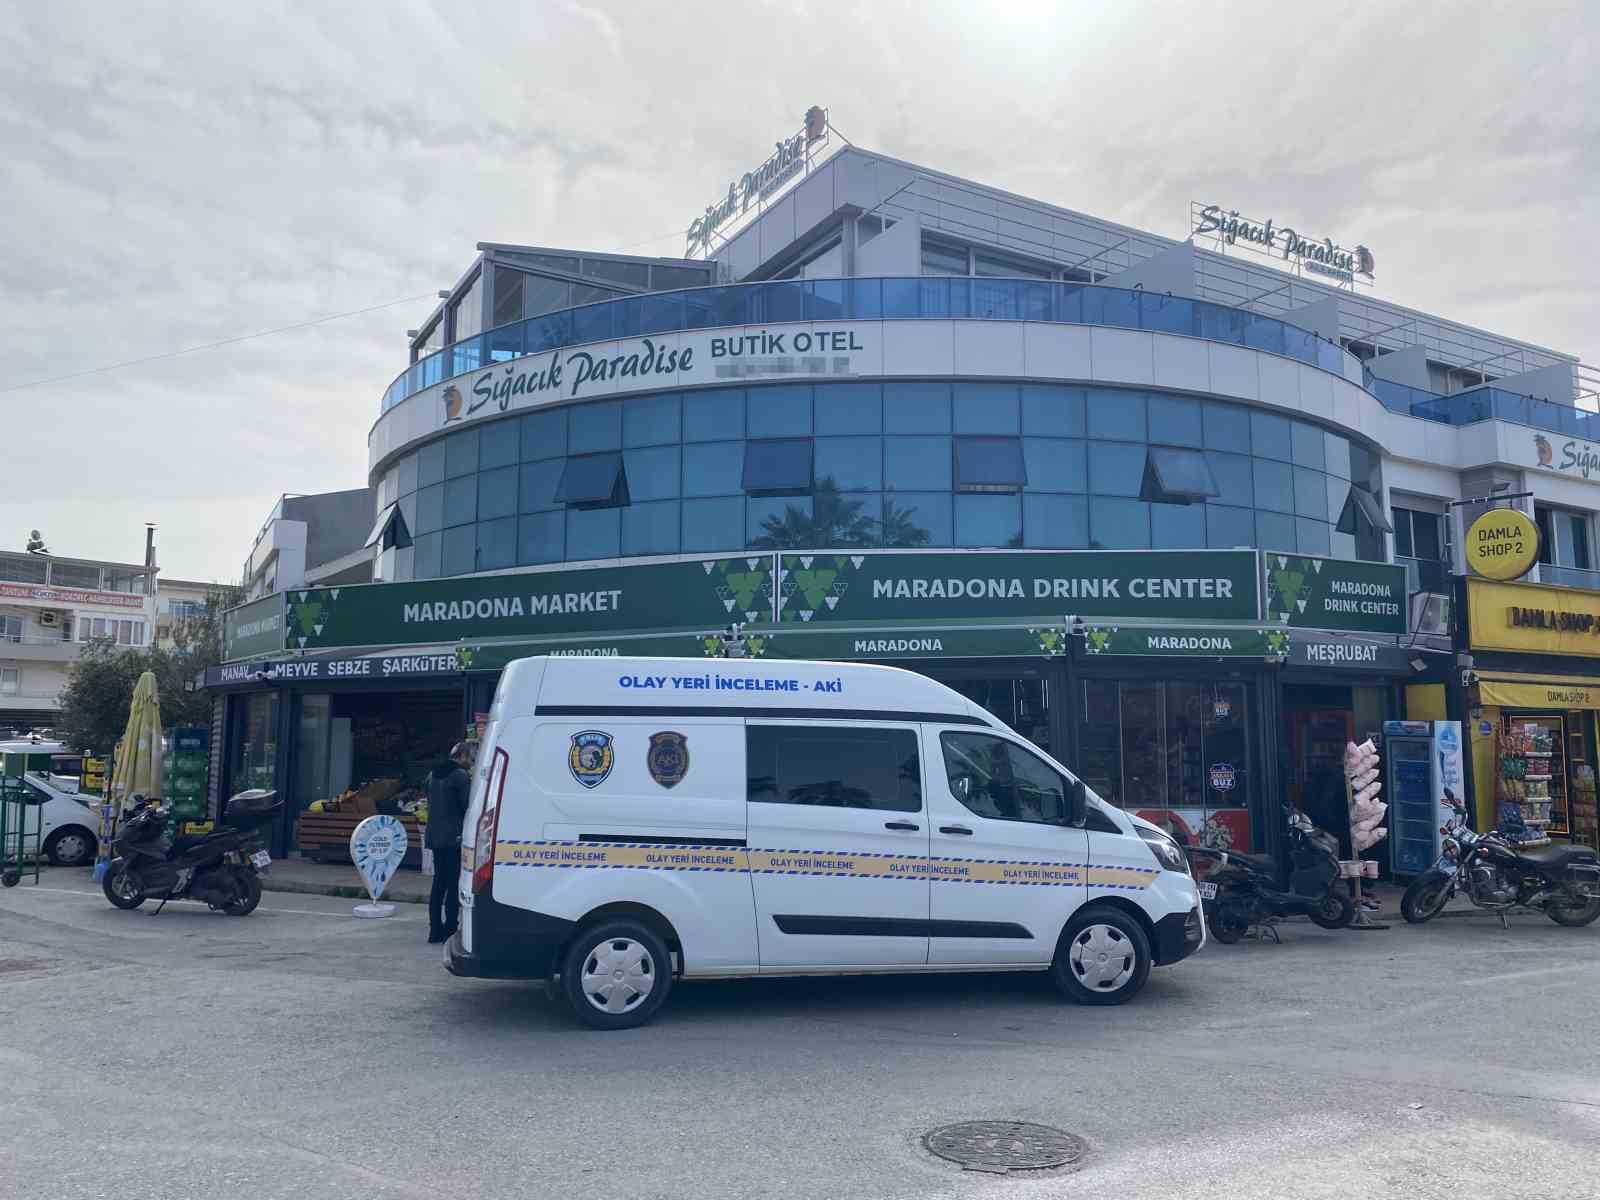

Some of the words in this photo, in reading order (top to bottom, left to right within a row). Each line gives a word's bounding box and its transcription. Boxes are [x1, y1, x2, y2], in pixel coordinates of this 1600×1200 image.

[1279, 228, 1354, 270] Paradise
[711, 331, 785, 358] BUTİK
[794, 331, 864, 352] OTEL
[466, 350, 562, 415] Sığacık
[566, 339, 694, 396] Paradise
[1559, 441, 1600, 480] Sığa
[1479, 526, 1522, 541] DAMLA
[1479, 542, 1513, 557] SHOP
[1515, 542, 1523, 553] 2
[872, 578, 1025, 599] MARADONA
[1033, 578, 1120, 599] DRINK
[1128, 578, 1233, 599] CENTER
[1331, 580, 1391, 598] MARADONA
[403, 596, 524, 623] MARADONA
[531, 590, 622, 615] MARKET
[1324, 598, 1359, 613] DRINK
[1360, 599, 1400, 616] CENTER
[1511, 606, 1560, 631] DAMLA
[854, 638, 943, 653] MARADONA
[1147, 635, 1232, 650] MARADONA
[1306, 643, 1378, 665] MEŞRUBAT
[221, 665, 249, 681] MANAV
[275, 662, 319, 677] MEYVE
[328, 659, 371, 676] SEBZE
[382, 655, 457, 677] ŞARKÜTER
[619, 676, 667, 689] OLAY
[671, 674, 710, 690] YERİ
[715, 674, 799, 692] İNCELEME
[814, 677, 843, 693] AKİ
[513, 849, 537, 858] OLAY
[770, 858, 791, 867] OLAY
[889, 863, 910, 872] OLAY
